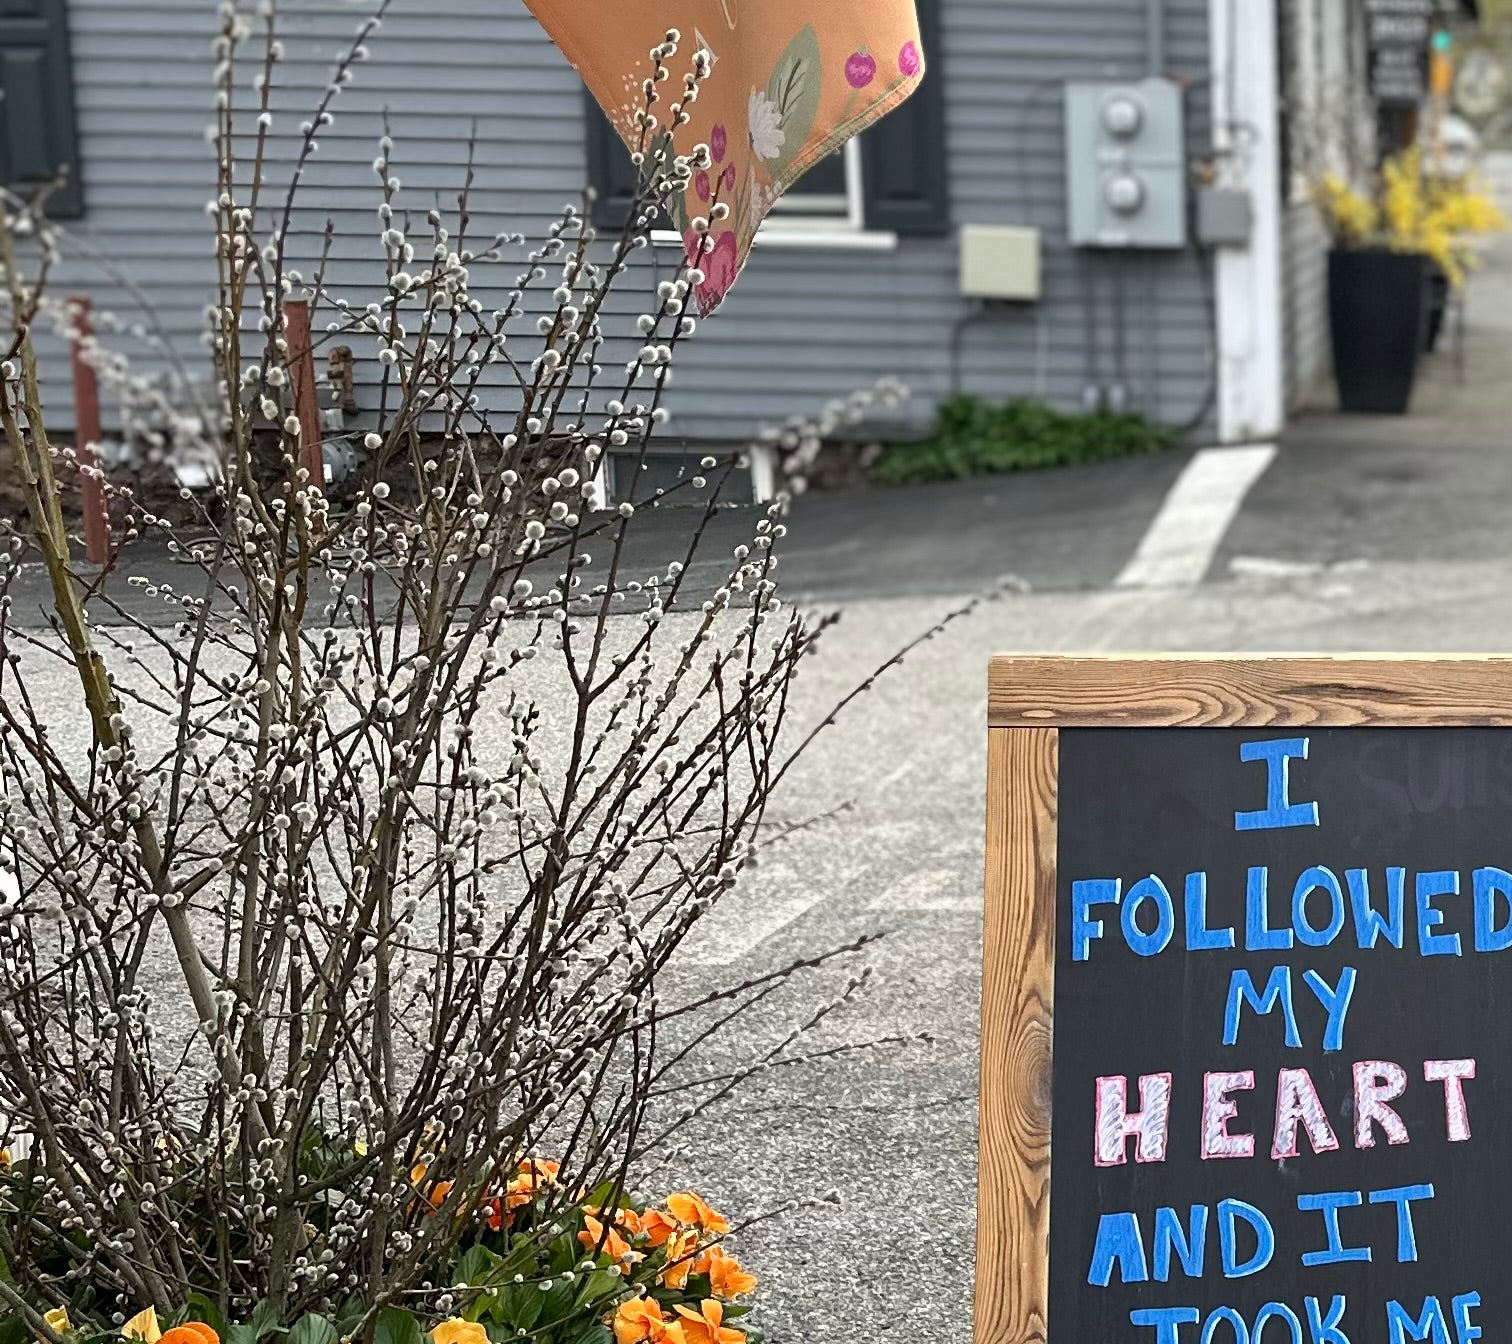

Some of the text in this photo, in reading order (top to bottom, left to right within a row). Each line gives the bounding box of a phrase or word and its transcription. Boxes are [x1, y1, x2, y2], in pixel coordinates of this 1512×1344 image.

[1234, 736, 1321, 832] I
[1221, 964, 1358, 1051] MY
[1093, 1058, 1477, 1167] HEART
[1087, 1182, 1436, 1288] AND IT
